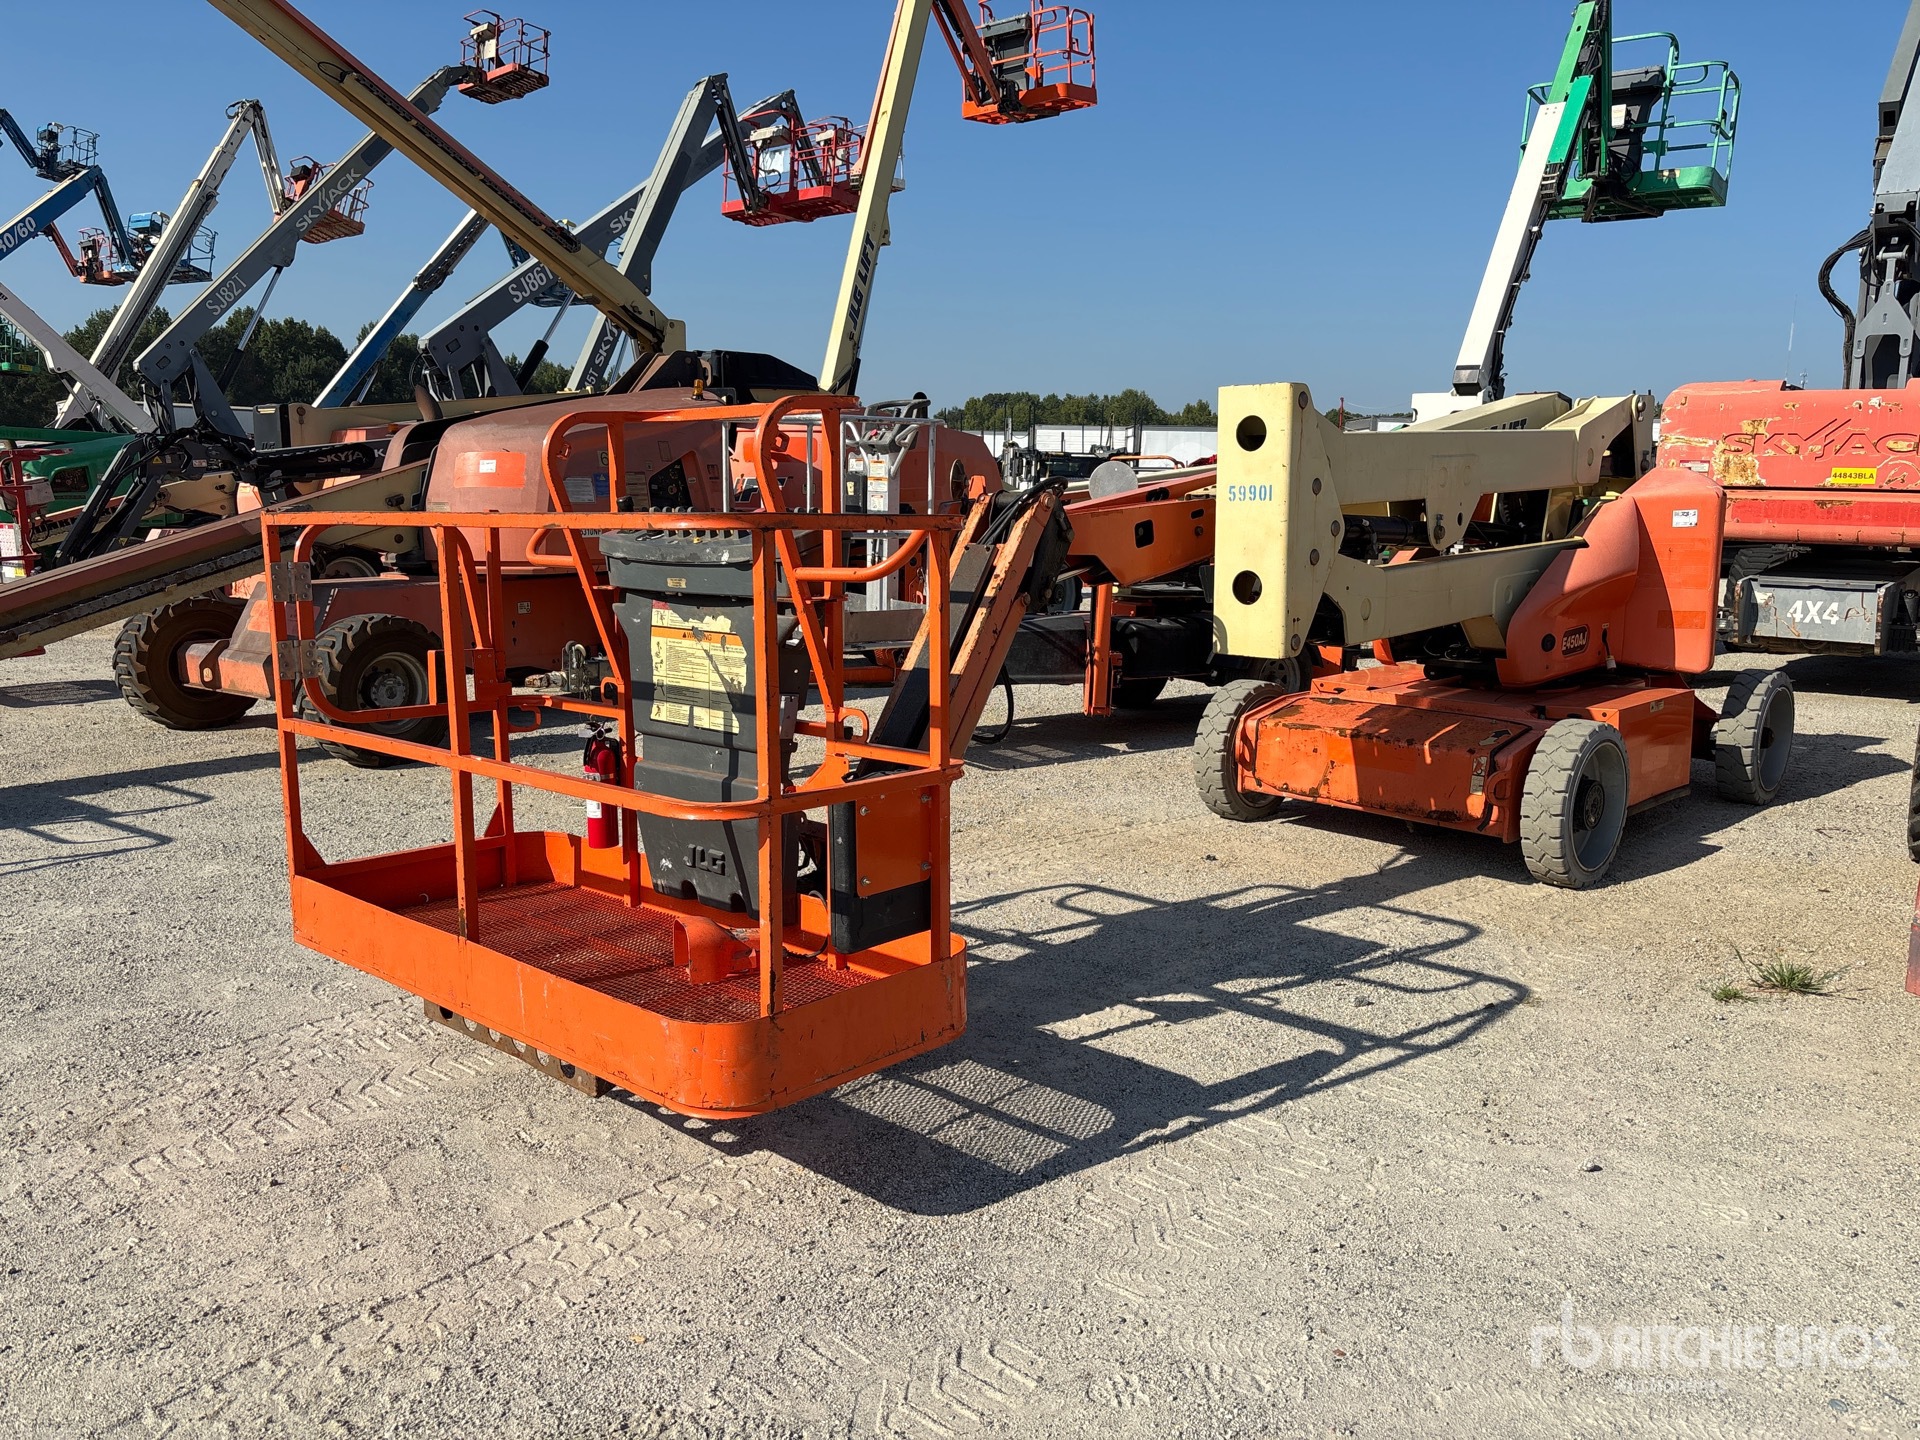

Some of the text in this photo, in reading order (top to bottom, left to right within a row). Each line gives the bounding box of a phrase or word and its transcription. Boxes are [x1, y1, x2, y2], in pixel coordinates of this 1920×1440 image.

[295, 167, 362, 232] SKYJACK
[205, 272, 247, 316] SJ82T
[848, 284, 864, 332] JLG
[858, 230, 875, 287] LIFT
[1723, 418, 1920, 461] SKYJAC
[317, 447, 386, 463] SKYJAK
[1832, 472, 1875, 480] 44843BLA
[1228, 484, 1273, 502] 59901
[1786, 600, 1840, 625] 4X4
[1561, 631, 1588, 651] E450AJ
[683, 843, 726, 876] JLG
